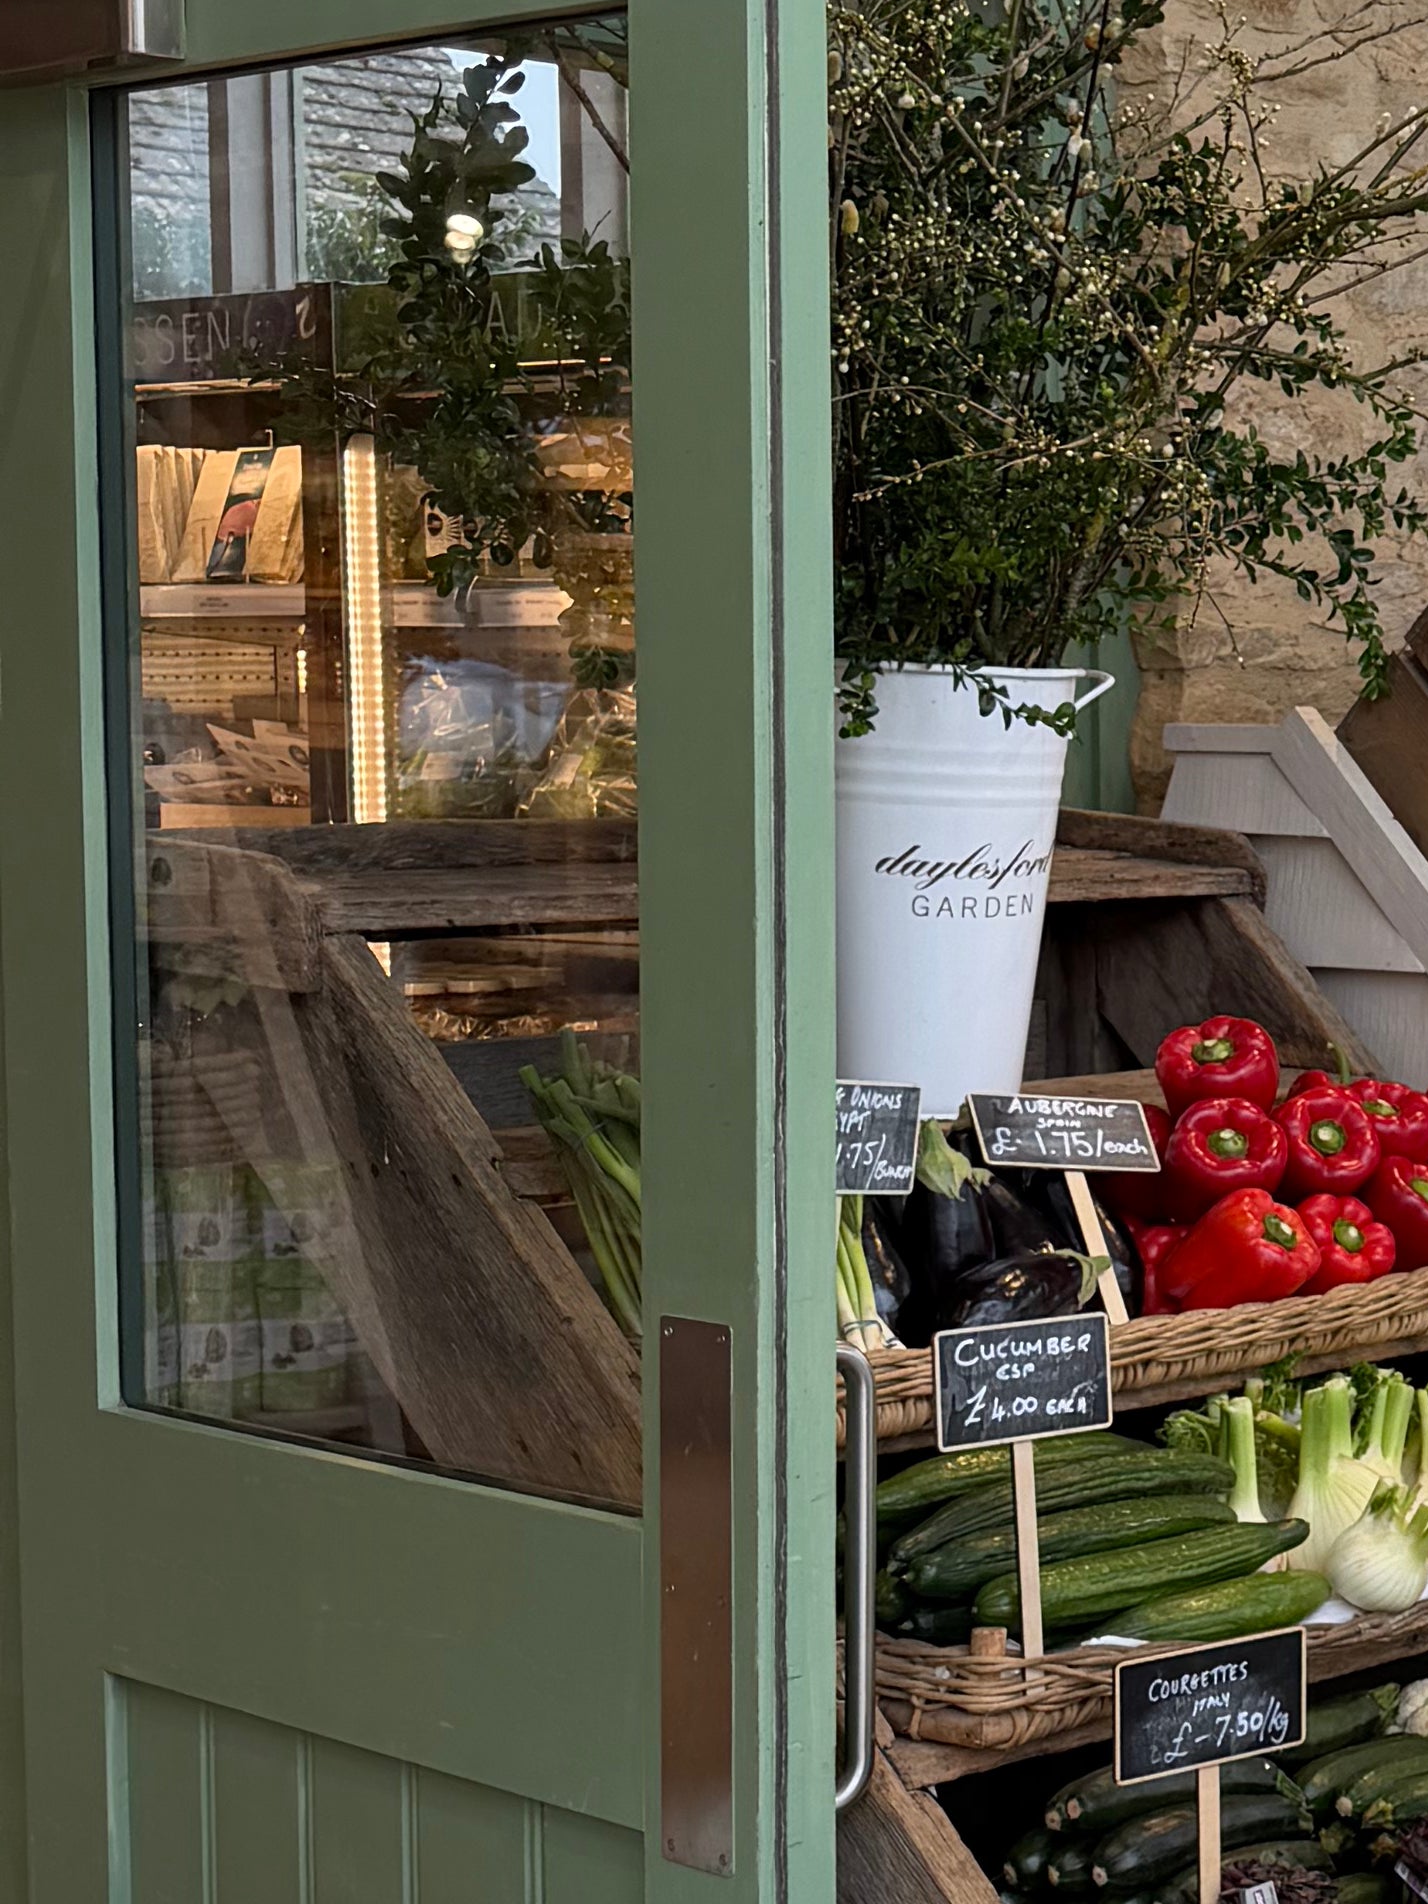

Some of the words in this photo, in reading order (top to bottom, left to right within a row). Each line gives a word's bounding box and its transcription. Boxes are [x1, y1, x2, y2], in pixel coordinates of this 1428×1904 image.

[911, 894, 1034, 919] GARDEN
[954, 1332, 1092, 1367] CUCUMBER
[995, 1362, 1036, 1381] ESP
[1148, 1660, 1249, 1702] COURGETTES
[1192, 1691, 1231, 1717] ITALY
